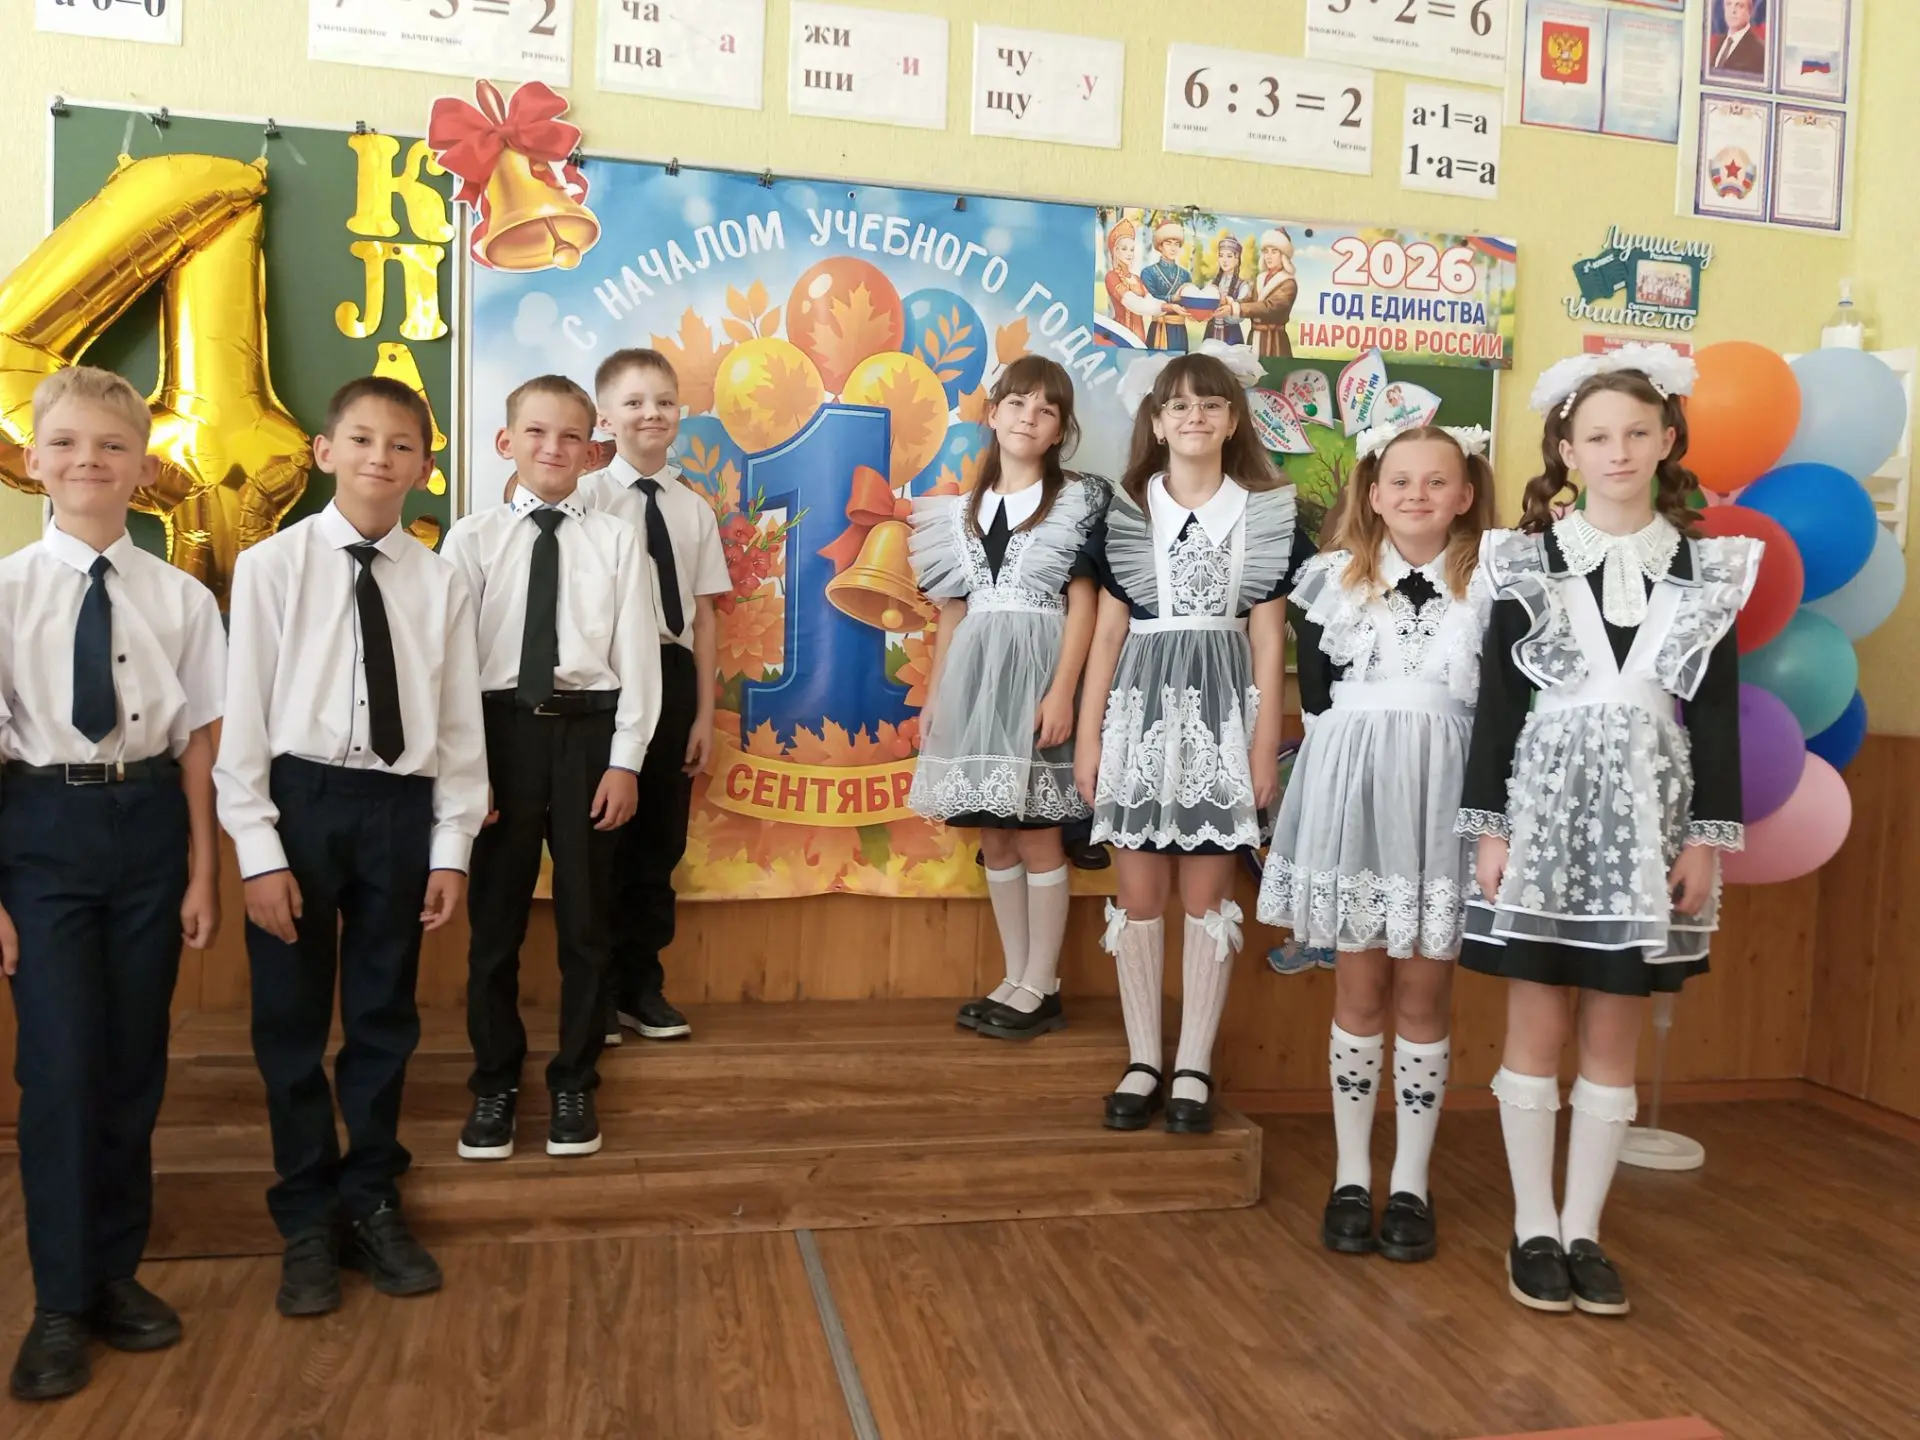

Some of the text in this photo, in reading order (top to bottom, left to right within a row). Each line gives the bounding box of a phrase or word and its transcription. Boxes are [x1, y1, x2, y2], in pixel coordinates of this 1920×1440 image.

[529, 0, 558, 36] 2
[622, 0, 659, 22] ча
[1470, 0, 1492, 36] 6
[719, 33, 736, 53] а
[804, 24, 851, 47] жи
[613, 44, 662, 70] ща
[903, 56, 919, 76] и
[997, 47, 1033, 76] чу
[804, 69, 853, 92] ши
[1082, 74, 1098, 100] у
[986, 90, 1032, 119] щу
[1184, 67, 1211, 109] 6
[1256, 76, 1280, 117] 3
[1338, 87, 1363, 128] 2
[1603, 223, 1714, 269] Лучшему
[1331, 236, 1476, 294] 2026
[562, 208, 1118, 389] С НАЧАЛОМ УЧЕБНОГО ГОДА!
[1319, 292, 1486, 325] ГОД ЕДИНСТВА
[1562, 295, 1695, 331] Учителю
[1299, 322, 1503, 359] НАРОДОВ РОССИИ
[726, 763, 914, 814] СЕНТЯБР
